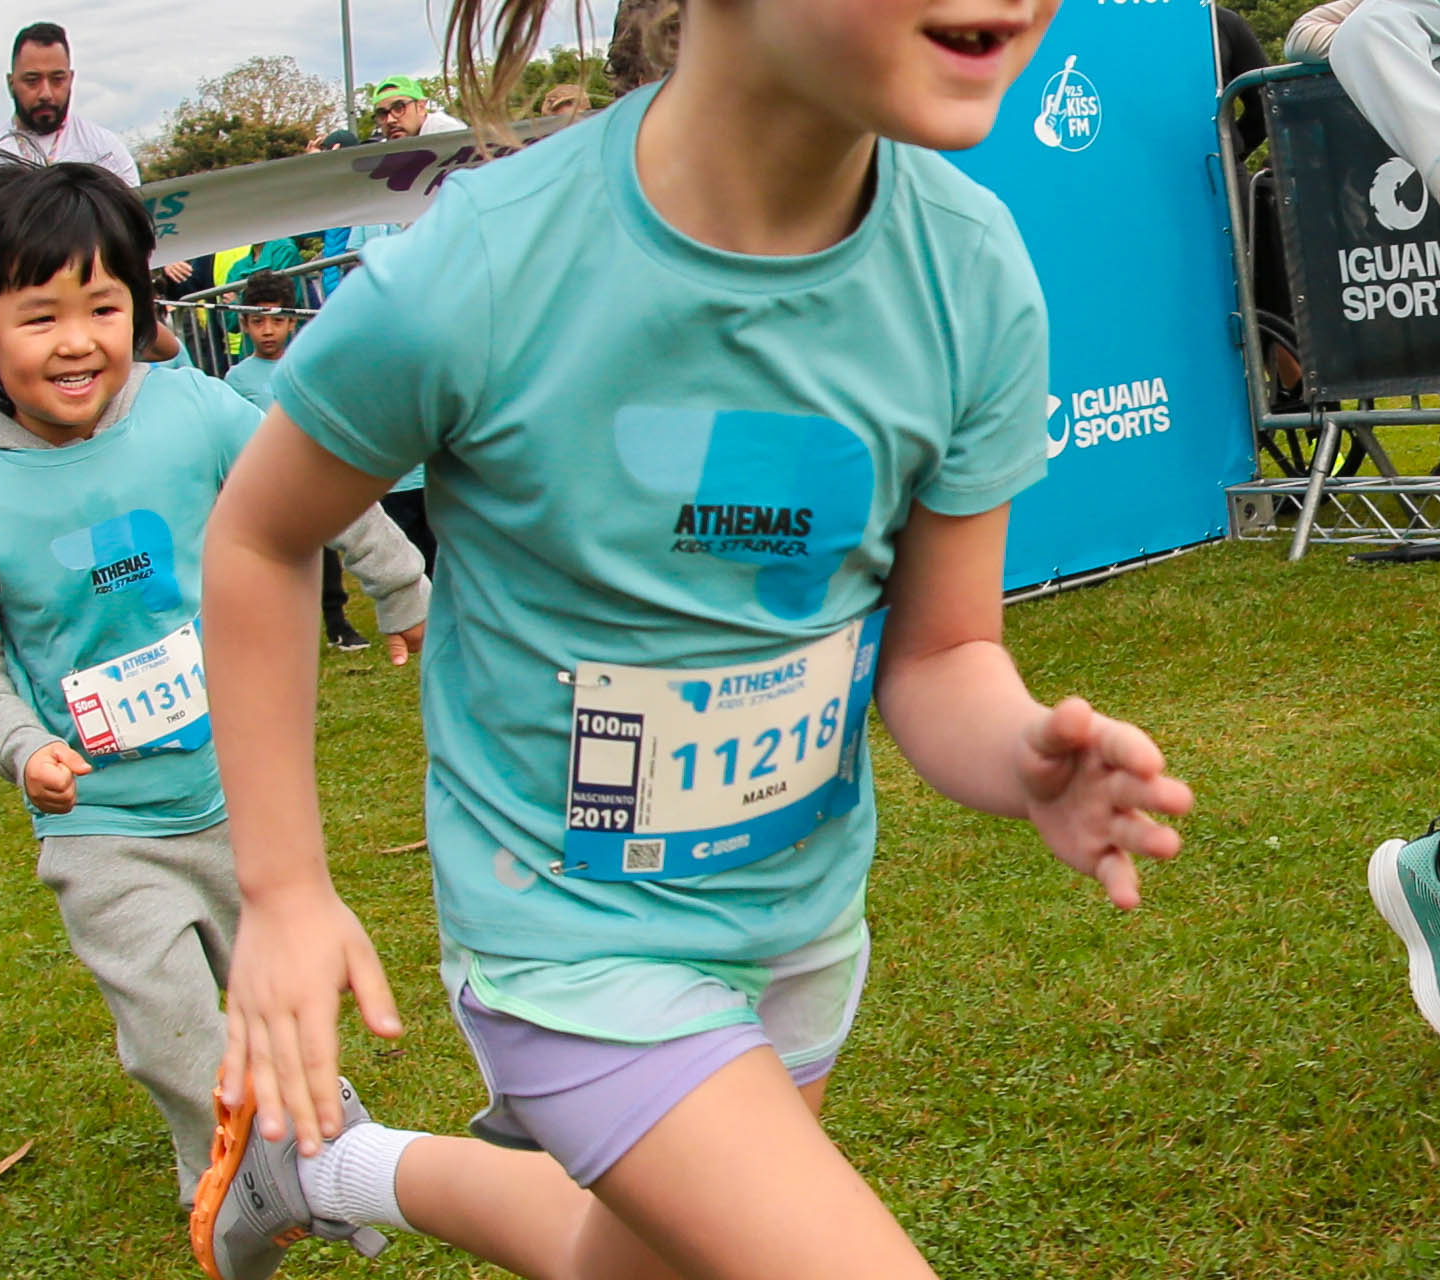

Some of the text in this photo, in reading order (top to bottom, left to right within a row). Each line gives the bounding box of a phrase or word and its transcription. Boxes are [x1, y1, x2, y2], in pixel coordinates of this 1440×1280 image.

[1066, 96, 1097, 116] KISS
[1068, 118, 1090, 137] FM
[1072, 378, 1169, 420] IGUANA
[1073, 406, 1170, 449] SPORTS
[674, 504, 812, 537] ATHENAS
[670, 538, 810, 557] KIDS STRONGER
[91, 552, 151, 586] ATHENAS
[123, 645, 167, 672] ATHENAS
[718, 658, 807, 697] ATHENAS
[74, 698, 98, 714] 50m
[117, 663, 205, 724] 11311
[578, 713, 642, 737] 100m
[672, 697, 841, 791] 11218
[742, 781, 788, 806] MARIA
[570, 806, 630, 830] 2019
